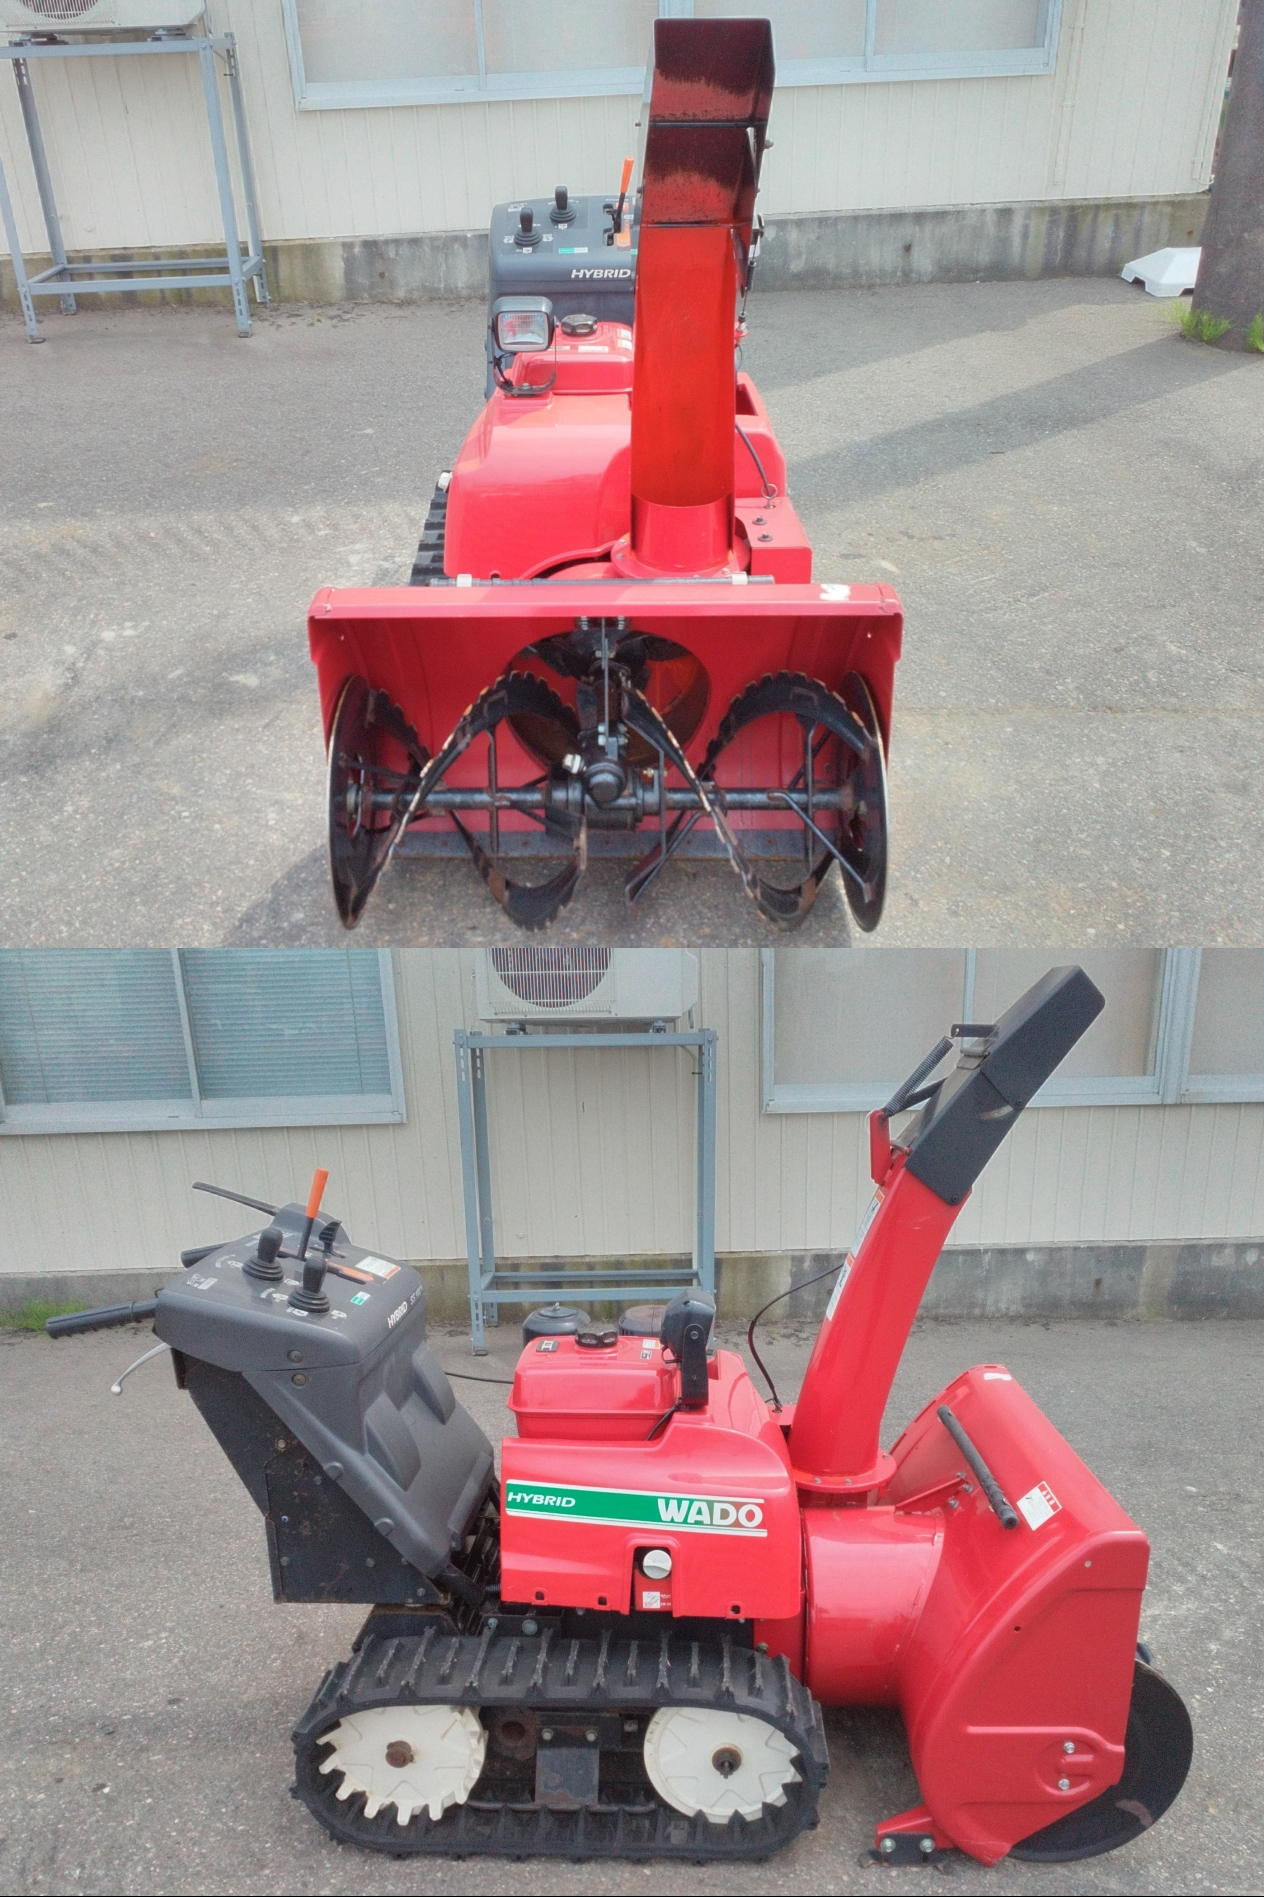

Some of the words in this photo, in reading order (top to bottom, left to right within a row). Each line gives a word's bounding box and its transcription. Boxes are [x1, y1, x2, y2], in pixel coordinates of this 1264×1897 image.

[571, 268, 631, 279] HYBRID
[507, 1492, 576, 1508] HYBRID
[657, 1498, 763, 1528] WADO
